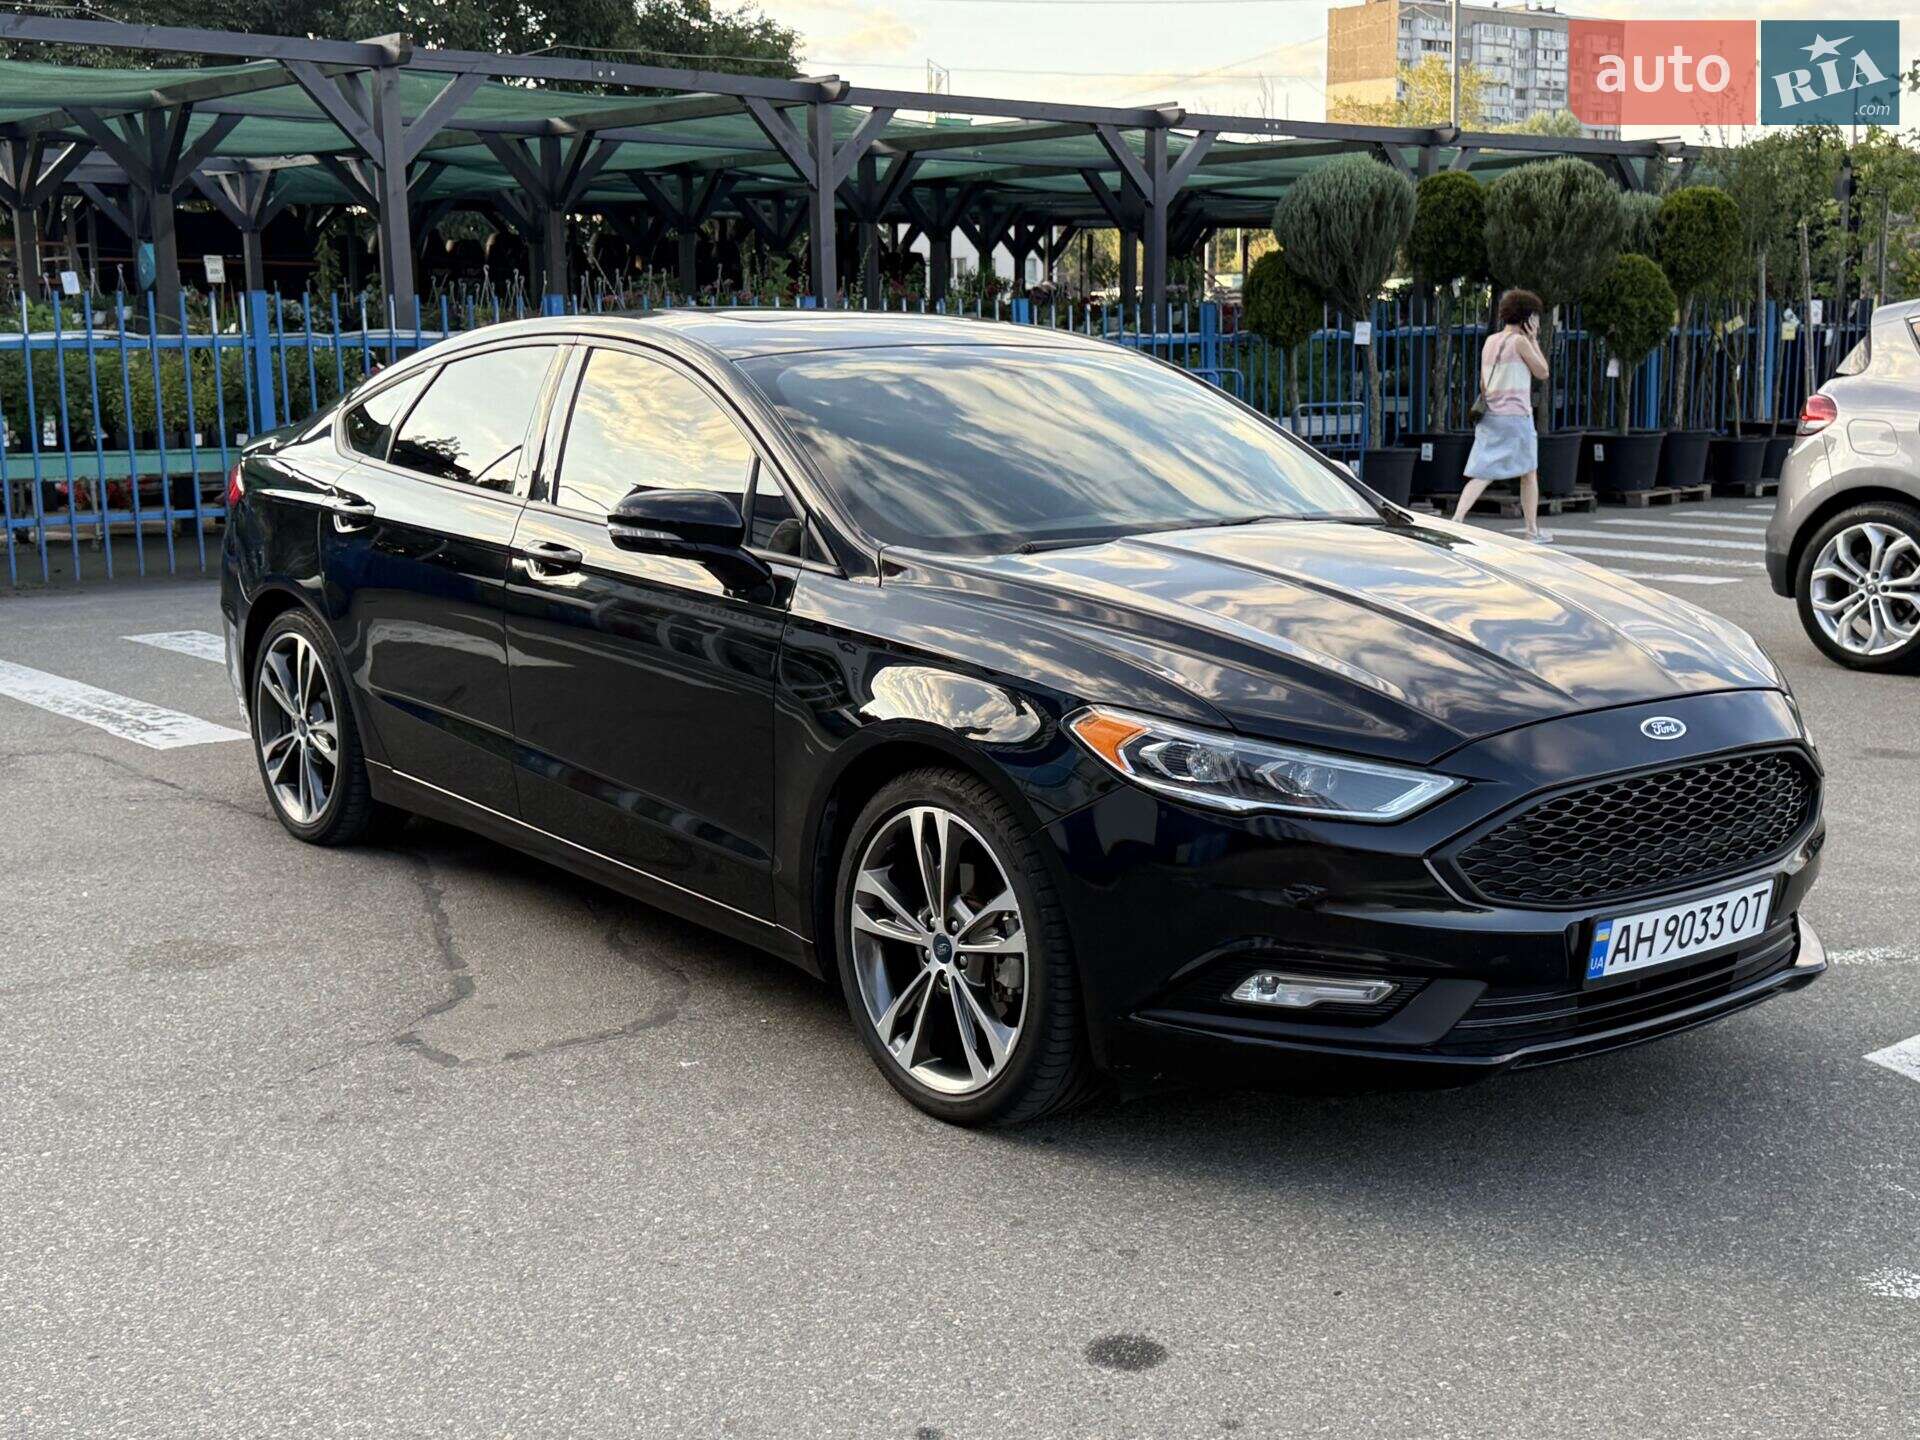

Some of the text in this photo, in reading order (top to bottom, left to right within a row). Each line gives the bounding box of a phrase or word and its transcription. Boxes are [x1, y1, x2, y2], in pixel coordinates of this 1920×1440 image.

[1651, 721, 1677, 735] Ford
[1609, 889, 1769, 966] AH 9033 OT
[1590, 956, 1604, 970] UA
